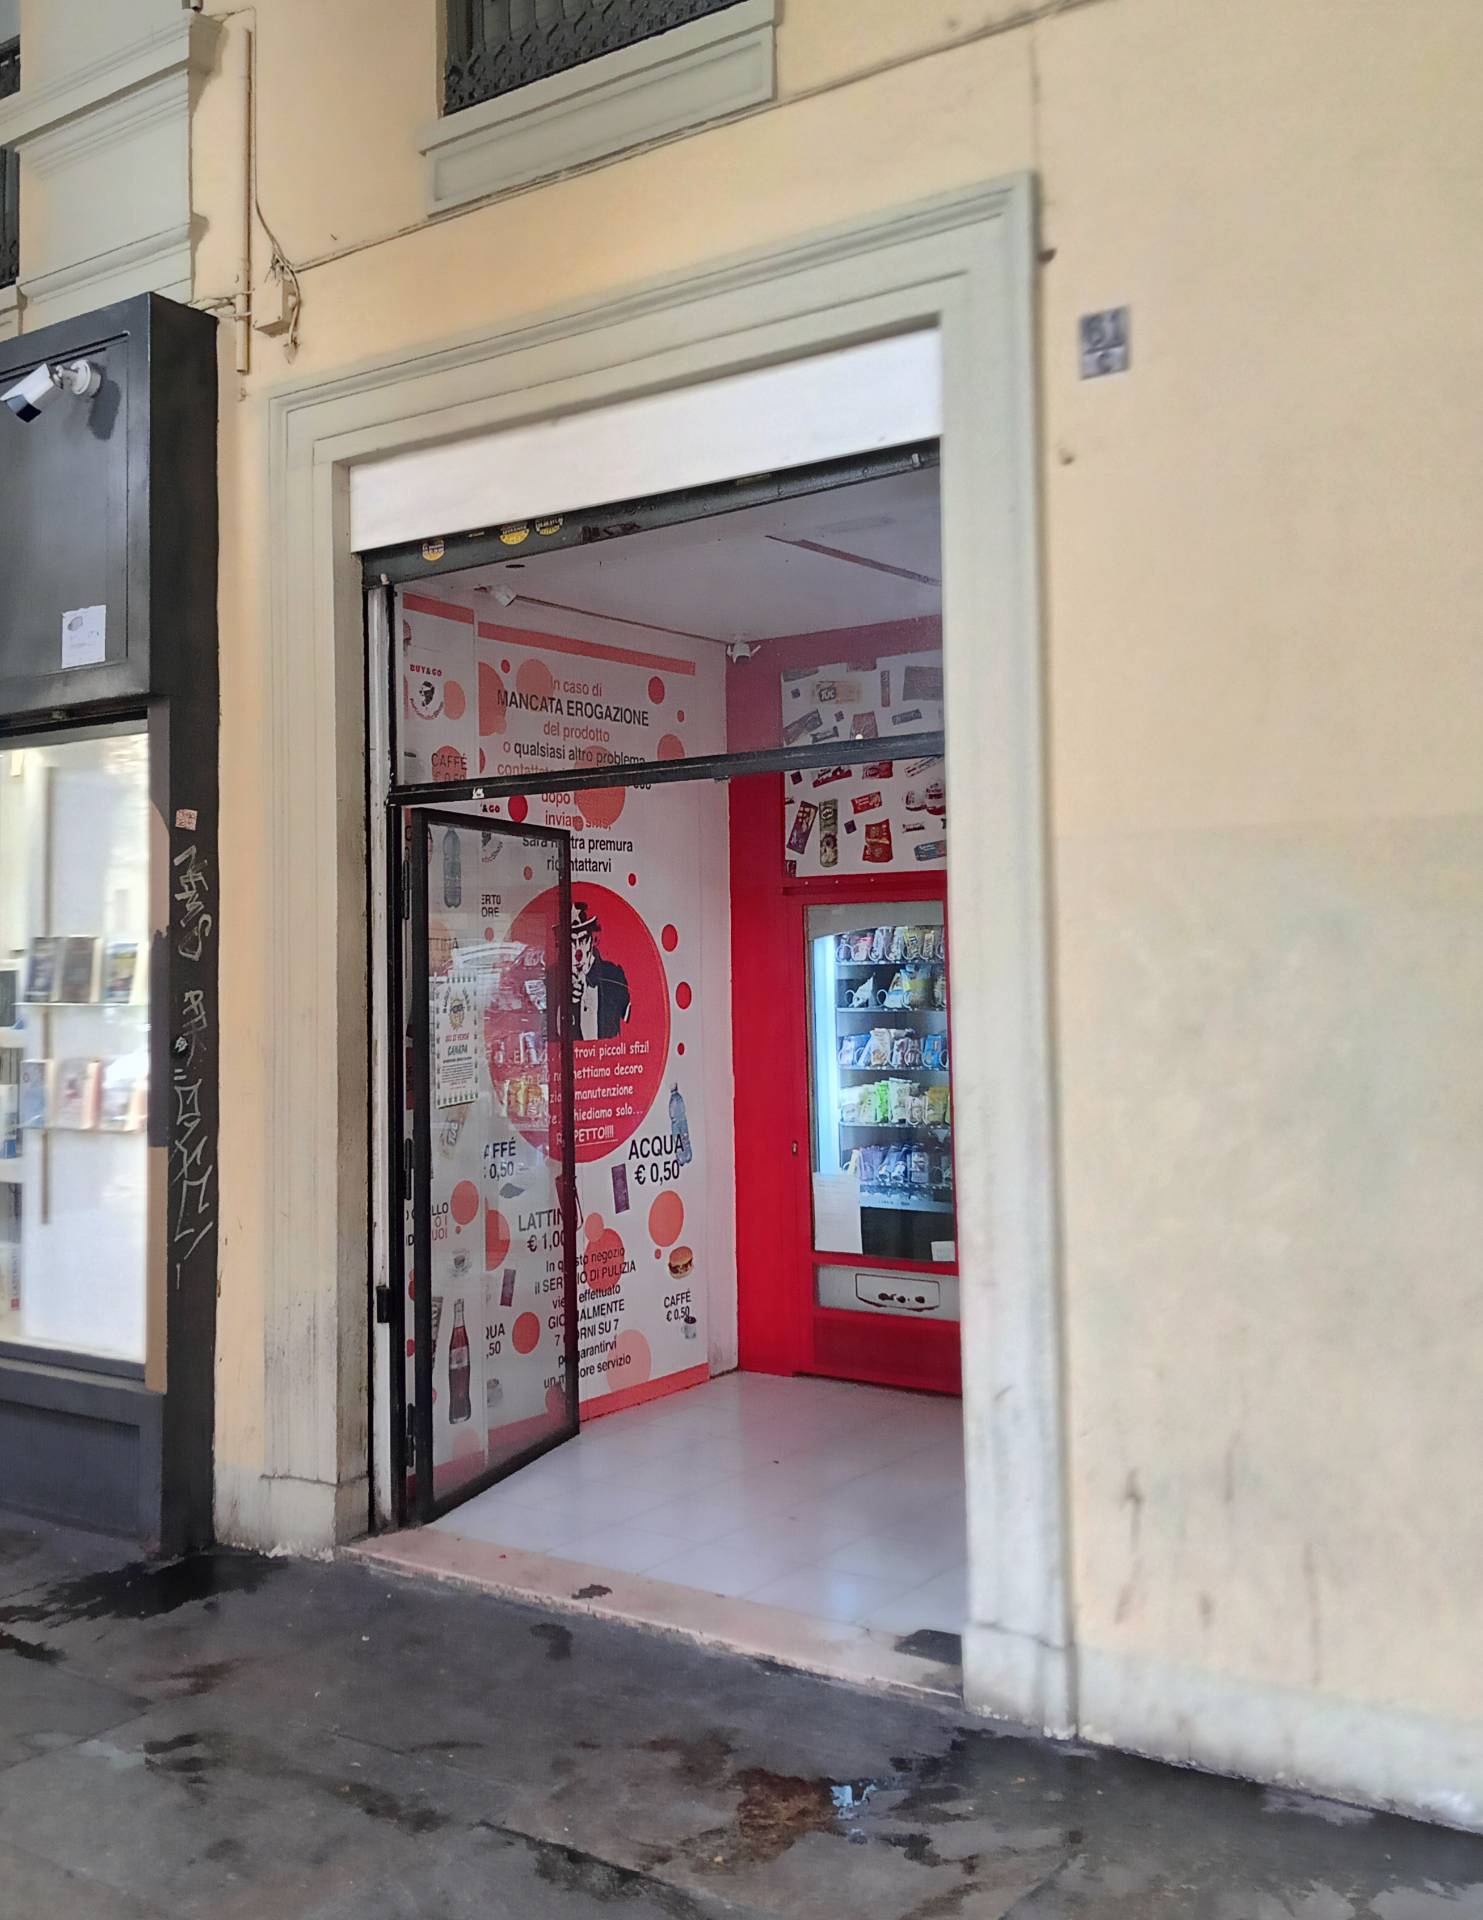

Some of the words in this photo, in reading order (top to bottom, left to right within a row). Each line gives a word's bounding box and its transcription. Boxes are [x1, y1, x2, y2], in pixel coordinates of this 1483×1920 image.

[563, 680, 589, 695] caso
[592, 683, 602, 697] di
[497, 690, 563, 716] MANCATA
[567, 700, 649, 727] EROGAZIONE
[543, 721, 560, 736] del
[563, 725, 610, 743] prodotto
[514, 742, 566, 759] qualsiasi
[568, 746, 593, 762] altro
[588, 839, 633, 853] premura
[547, 856, 611, 872] ricntattarvi
[575, 1046, 596, 1058] trovi
[599, 1043, 626, 1060] piccoli
[614, 1065, 643, 1075] decoro
[575, 1086, 633, 1098] manutenzione
[574, 1106, 612, 1121] hiediamo
[628, 1133, 685, 1160] ACQUA
[634, 1164, 646, 1185] €
[650, 1160, 680, 1186] 0,50
[527, 1235, 538, 1252] €
[546, 1261, 555, 1273] In
[591, 1247, 625, 1264] negozio
[590, 1269, 599, 1282] DI
[601, 1260, 636, 1279] PULIZIA
[579, 1284, 621, 1303] effettuato
[598, 1321, 611, 1335] SU
[613, 1319, 619, 1331] 7
[579, 1335, 617, 1359] arantirvi
[597, 1354, 631, 1373] servizio
